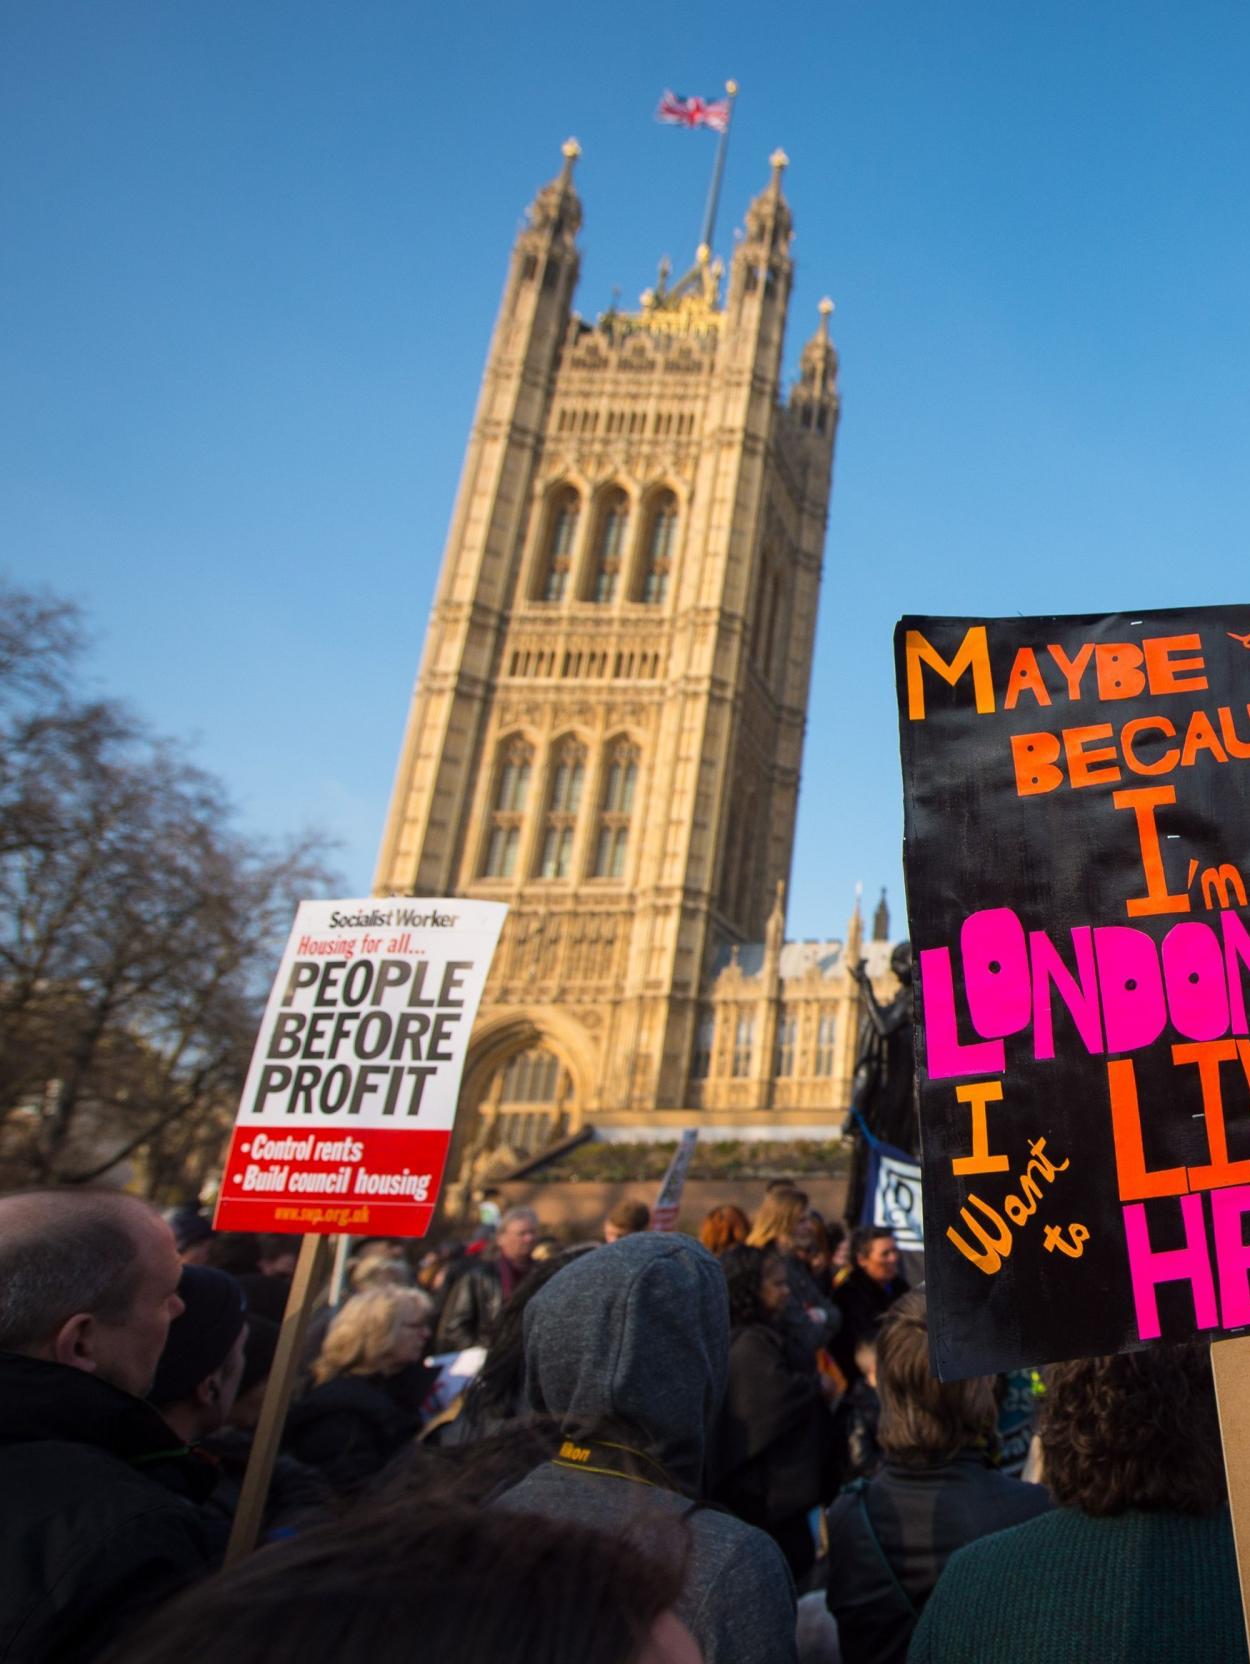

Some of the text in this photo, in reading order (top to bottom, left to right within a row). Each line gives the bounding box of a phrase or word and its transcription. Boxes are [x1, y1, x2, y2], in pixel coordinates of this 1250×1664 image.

[906, 626, 1208, 721] MAYBE
[1112, 784, 1248, 917] I'm
[328, 909, 459, 928] Socialist Worker
[297, 934, 357, 959] Housing
[361, 934, 386, 954] for
[281, 960, 474, 1008] PEOPLE
[266, 1010, 462, 1061] BEFORE
[252, 1064, 437, 1116] PROFIT
[251, 1134, 364, 1162] Control rents
[951, 1080, 1010, 1176] I
[242, 1165, 432, 1202] Build council housing
[946, 1136, 1070, 1275] Want
[1043, 1222, 1090, 1259] to
